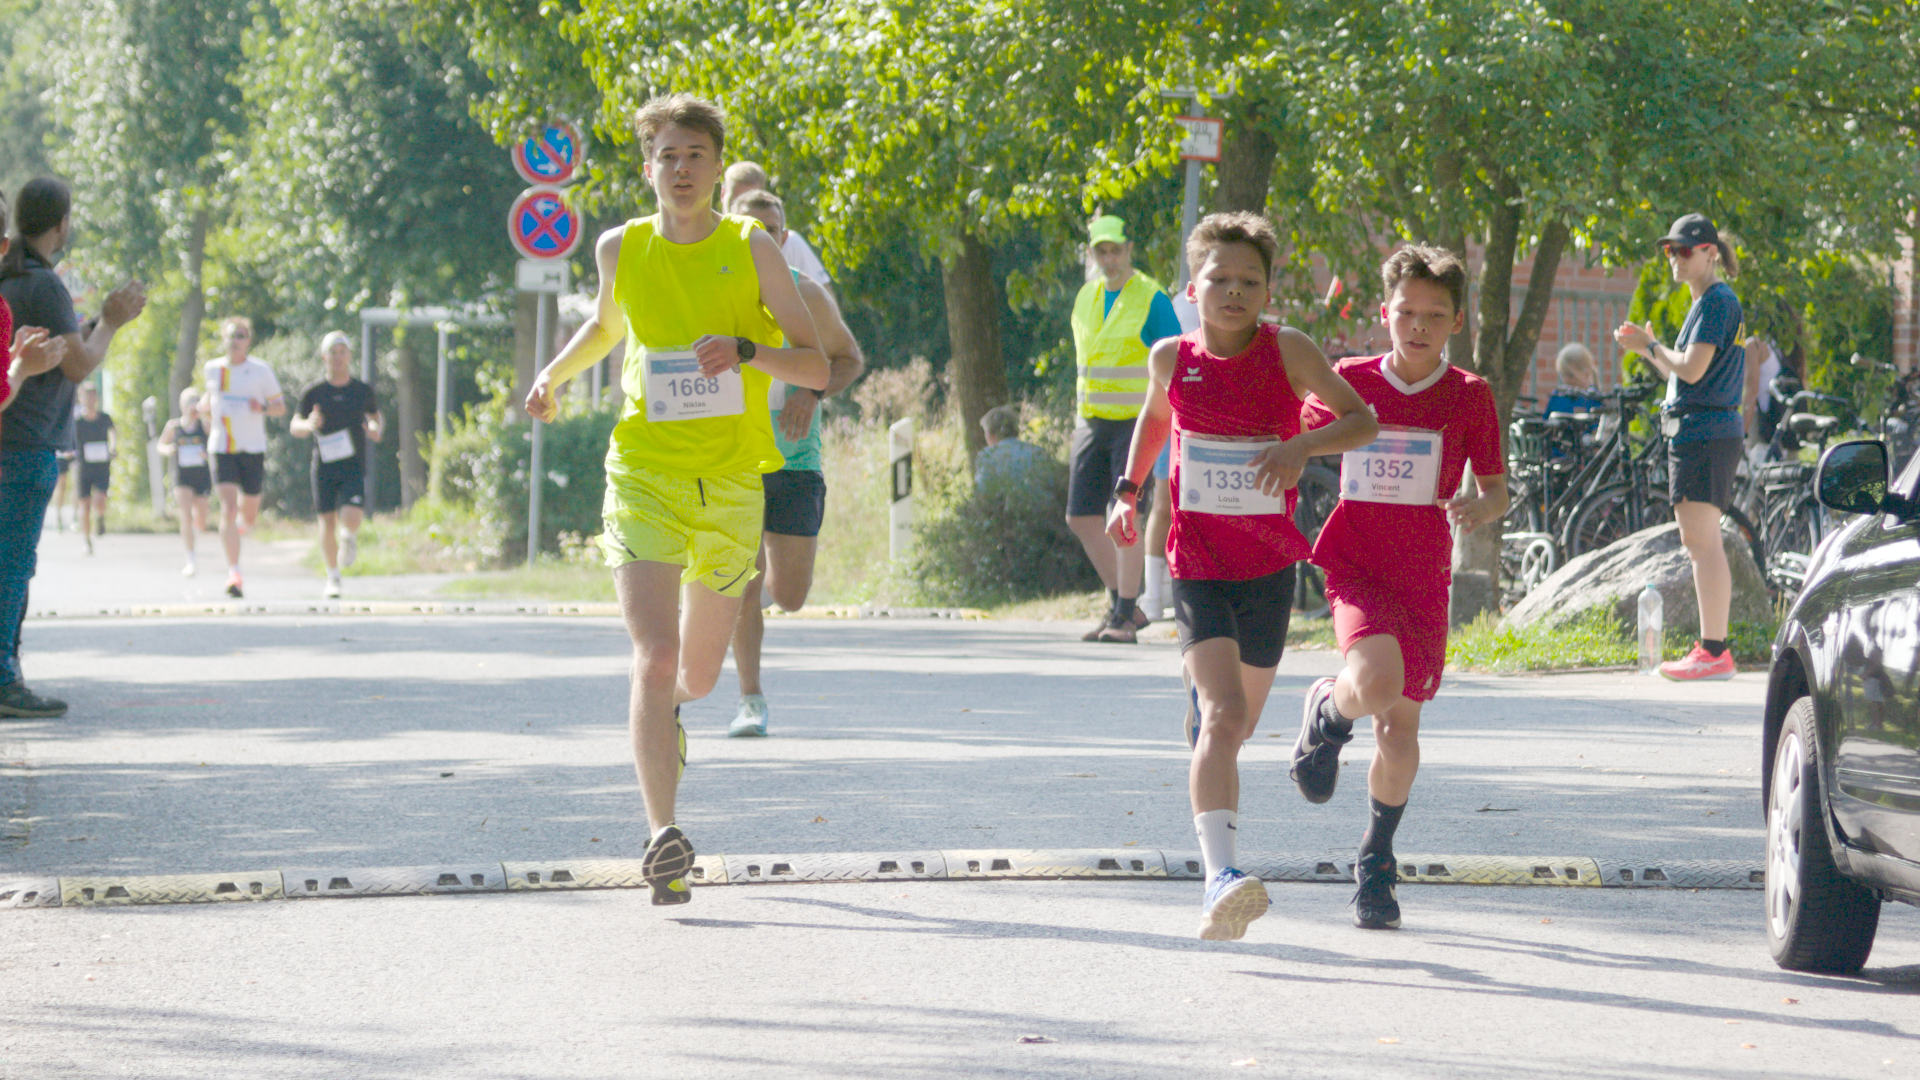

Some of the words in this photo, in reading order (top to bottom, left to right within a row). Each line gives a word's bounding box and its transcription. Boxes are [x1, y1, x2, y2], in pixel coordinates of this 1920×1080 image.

[668, 376, 720, 397] 1668
[1362, 458, 1414, 479] 1352
[1203, 469, 1256, 490] 1339
[1371, 483, 1401, 491] Vincent
[1217, 495, 1241, 503] Louis
